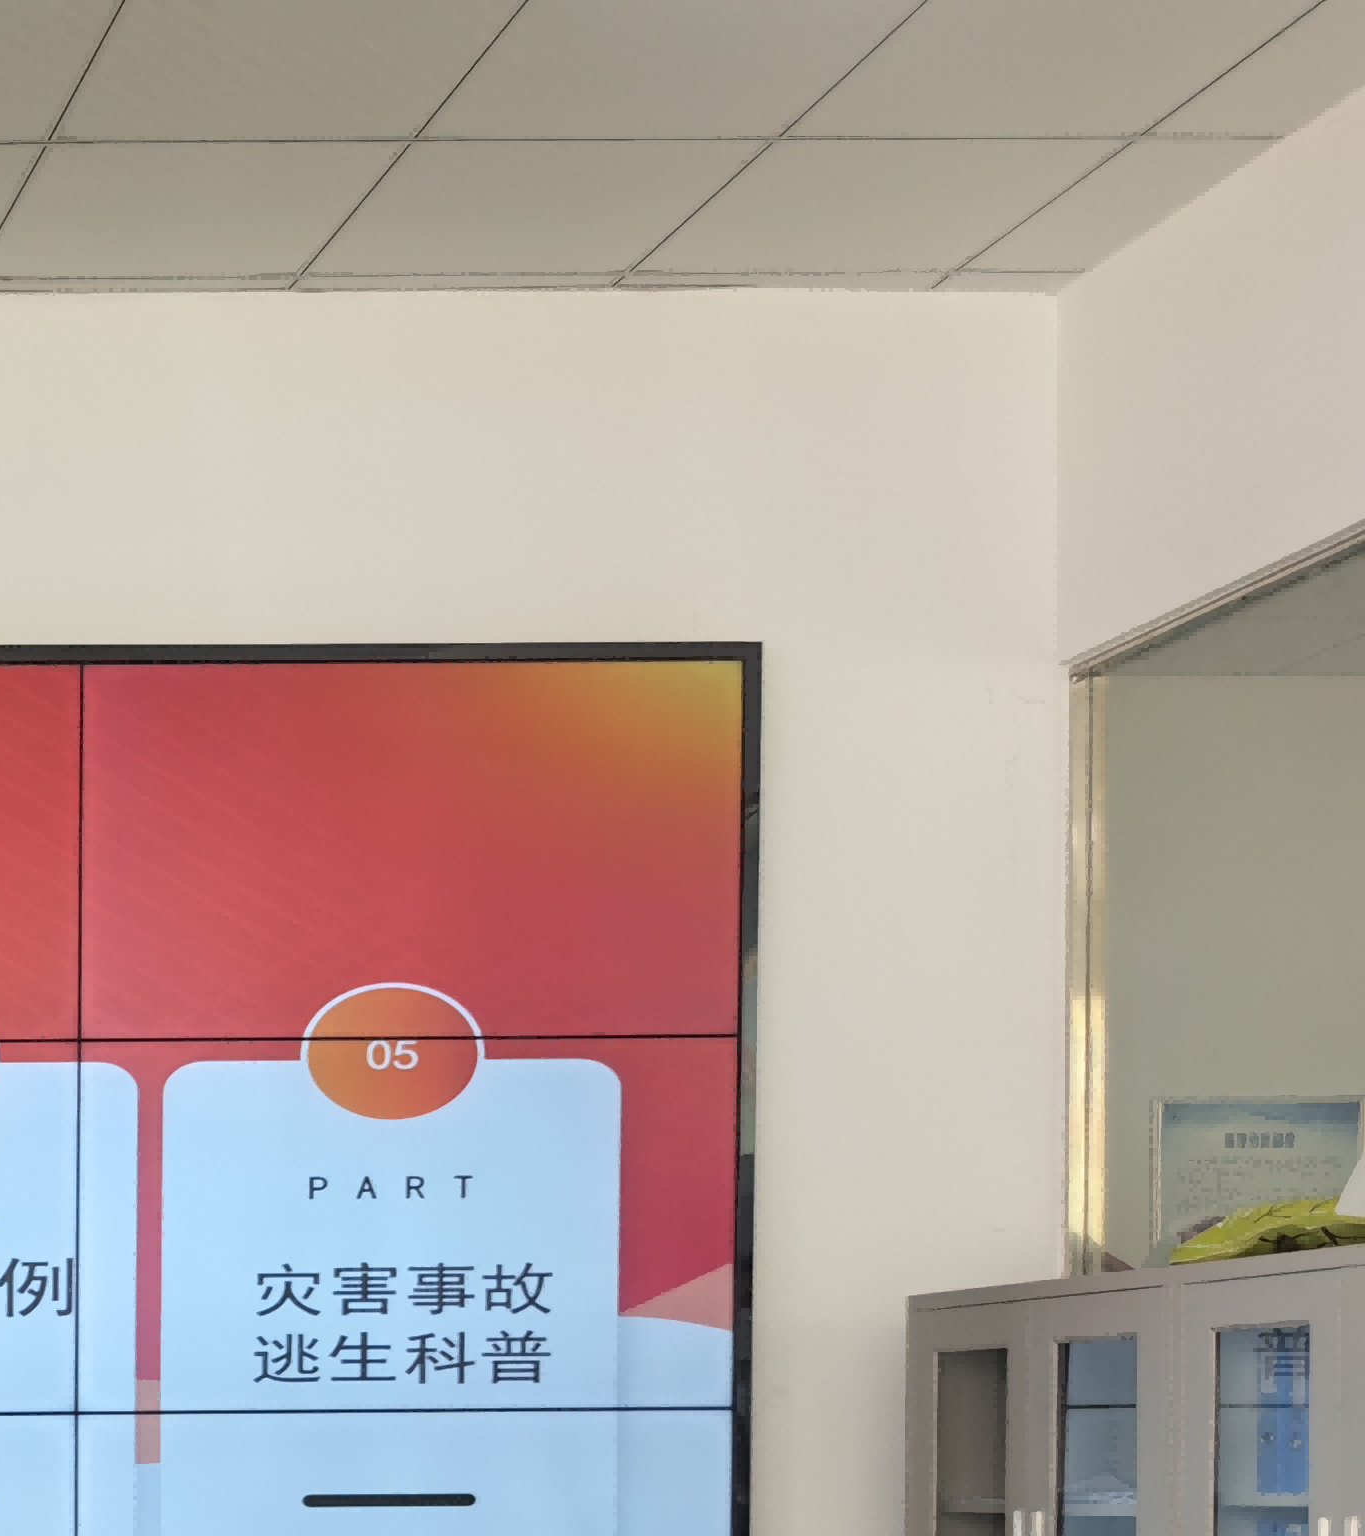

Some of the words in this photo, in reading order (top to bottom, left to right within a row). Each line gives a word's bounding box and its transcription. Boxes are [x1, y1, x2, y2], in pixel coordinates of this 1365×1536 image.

[366, 1040, 419, 1070] 05
[309, 1175, 473, 1200] PART
[256, 1262, 553, 1318] 灾害事故
[254, 1330, 552, 1386] 逃生科普
